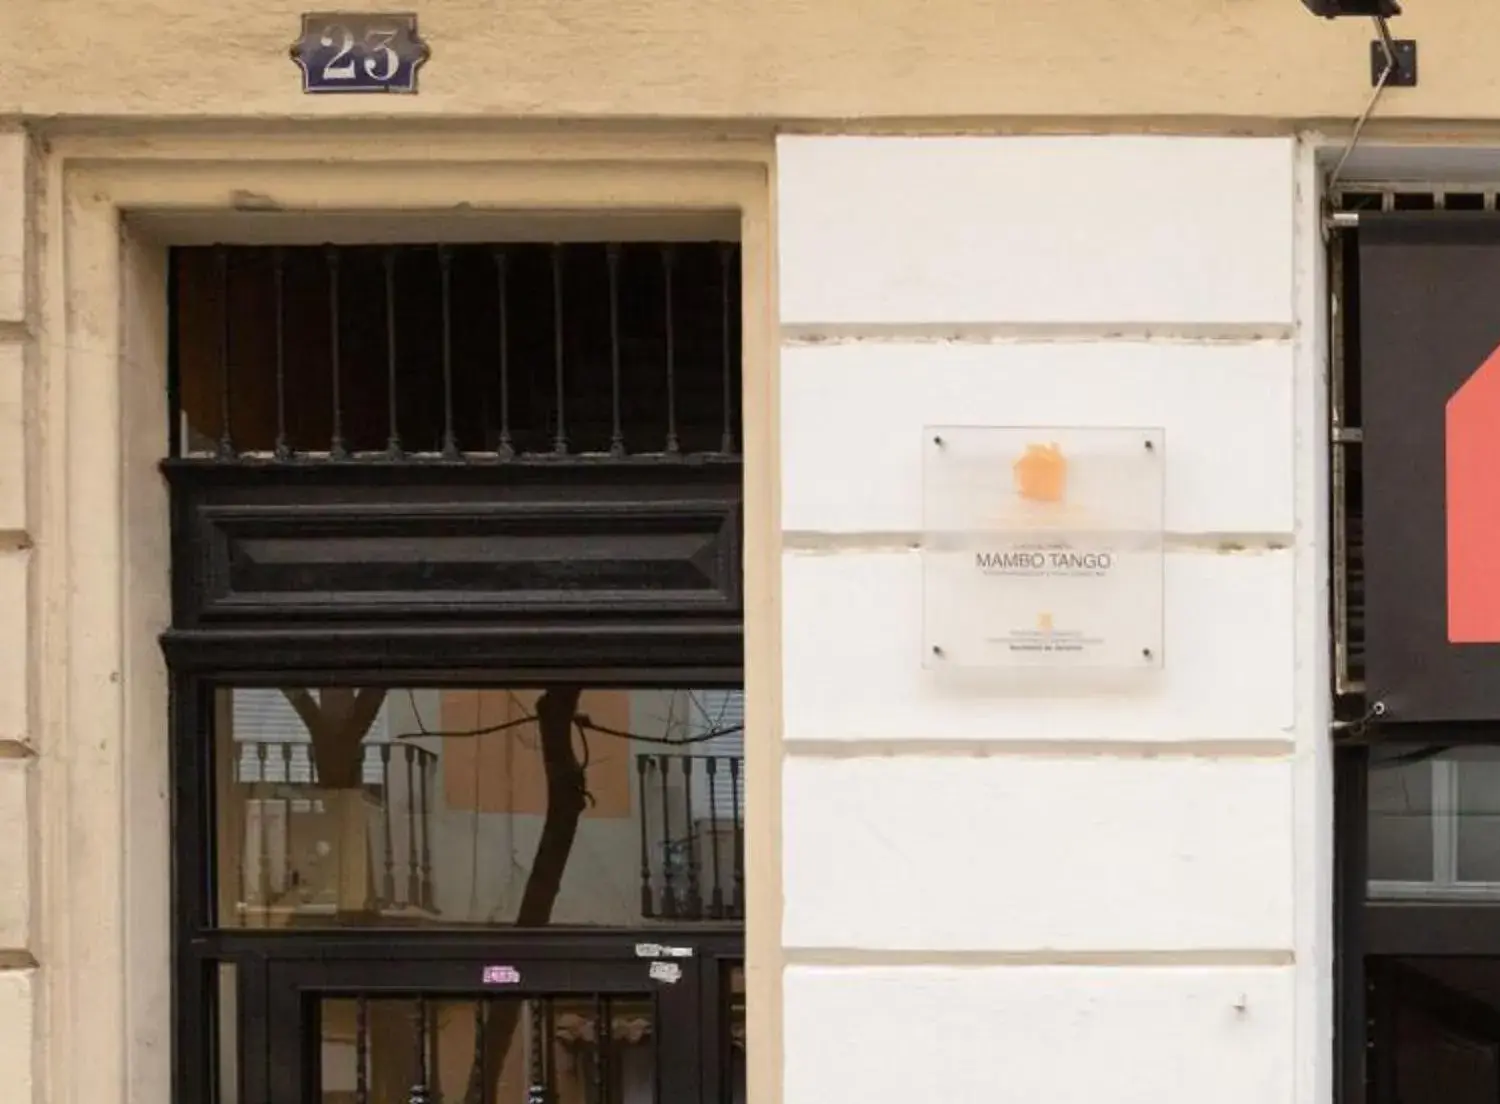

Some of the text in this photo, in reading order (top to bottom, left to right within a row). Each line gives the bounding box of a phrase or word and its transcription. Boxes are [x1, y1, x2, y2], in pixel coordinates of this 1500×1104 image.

[320, 23, 400, 80] 23
[975, 552, 1111, 569] MAMBO TANGO
